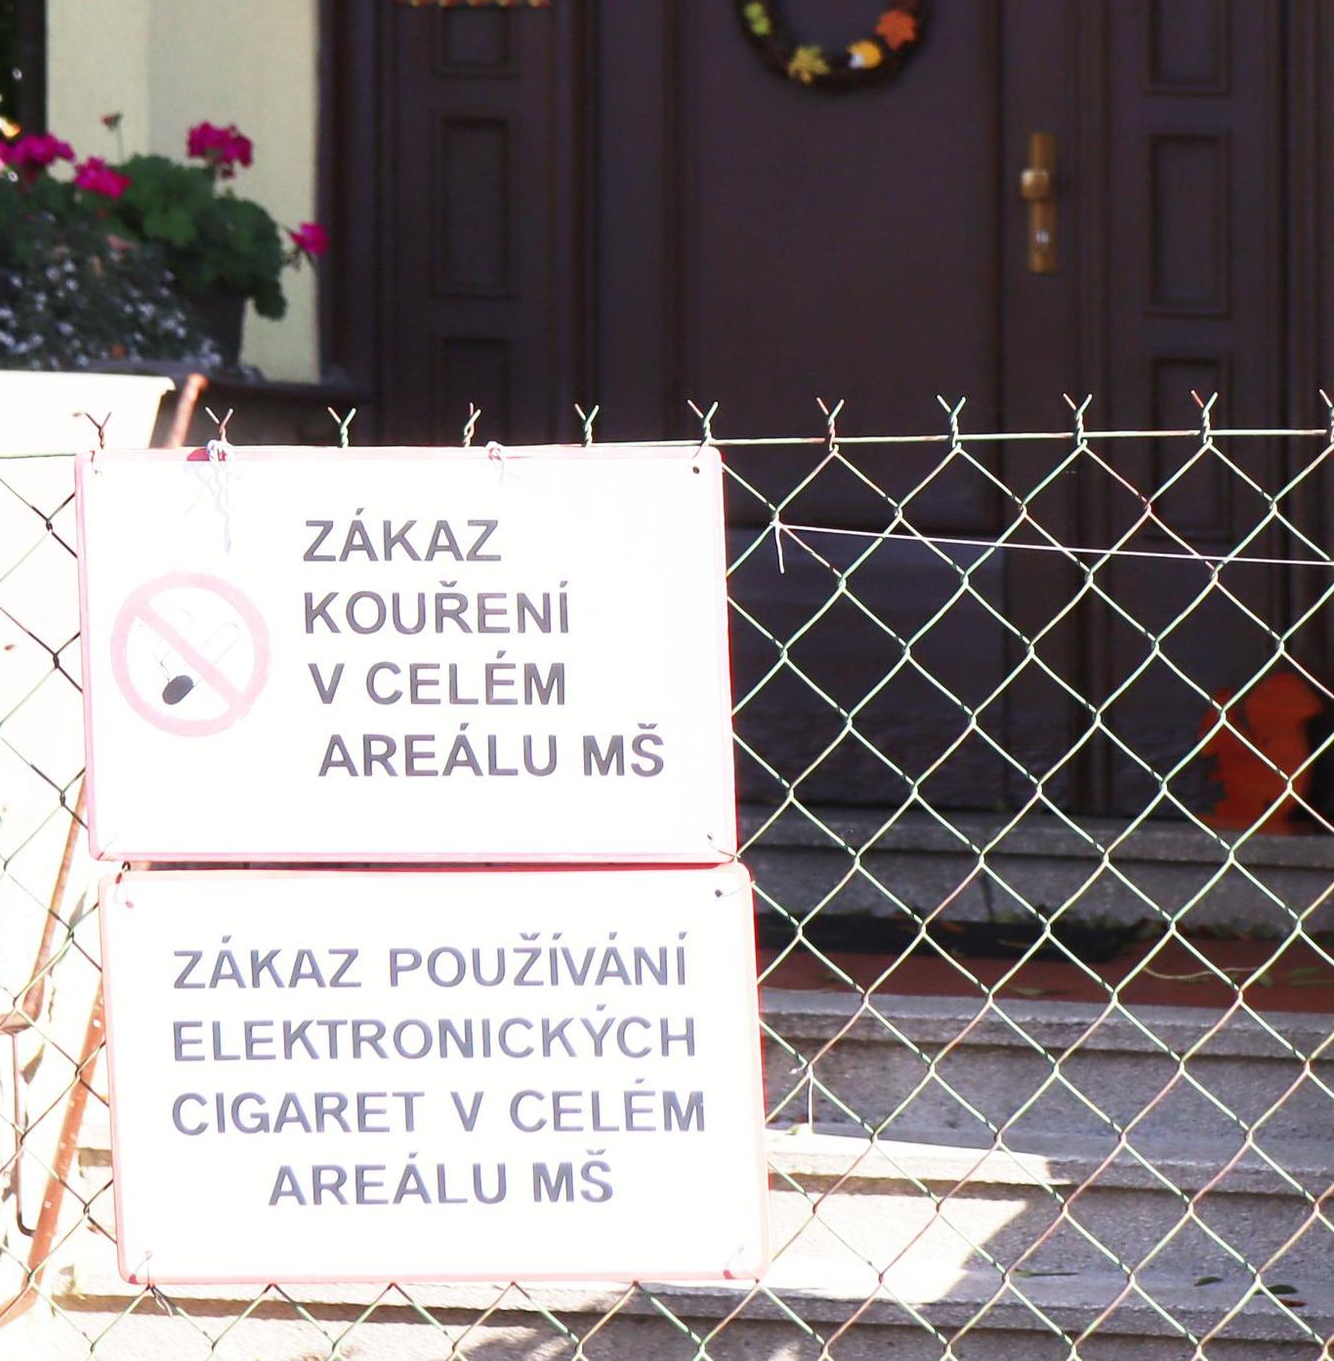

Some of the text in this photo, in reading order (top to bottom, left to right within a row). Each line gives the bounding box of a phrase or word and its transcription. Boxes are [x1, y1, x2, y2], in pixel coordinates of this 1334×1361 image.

[303, 507, 501, 562] ZÁKAZ
[304, 580, 569, 635] KOUŘENÍ
[308, 650, 566, 705] V CELÉM
[318, 723, 665, 778] AREÁLU MŠ
[174, 931, 688, 989] ZÁKAZ POUŽÍVÁNÍ
[173, 1004, 696, 1061] ELEKTRONICKÝCH
[172, 1078, 706, 1136] CIGARET V CELÉM
[268, 1149, 614, 1206] AREÁLU MŠ
